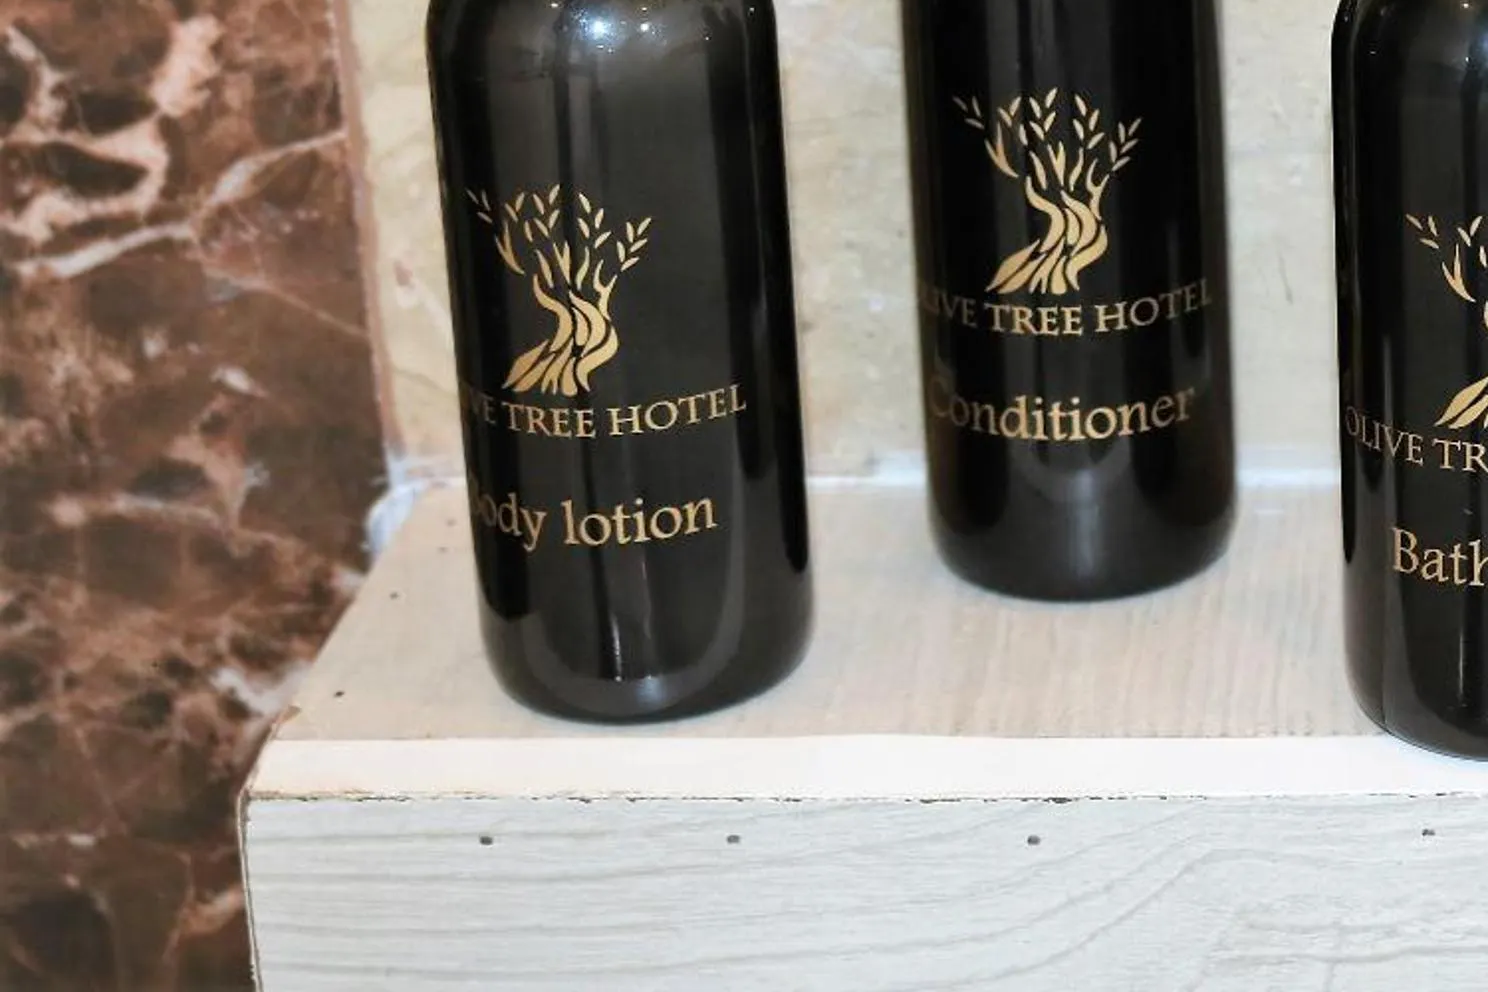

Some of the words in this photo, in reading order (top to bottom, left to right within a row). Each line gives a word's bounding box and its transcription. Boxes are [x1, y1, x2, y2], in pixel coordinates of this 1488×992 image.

[983, 302, 1084, 337] TREE
[1094, 277, 1211, 333] HOTEL
[501, 400, 596, 439] TREE
[606, 383, 747, 437] HOTEL
[927, 374, 1196, 442] Conditioner
[1344, 405, 1424, 467] OLIVE
[560, 496, 719, 547] lotion
